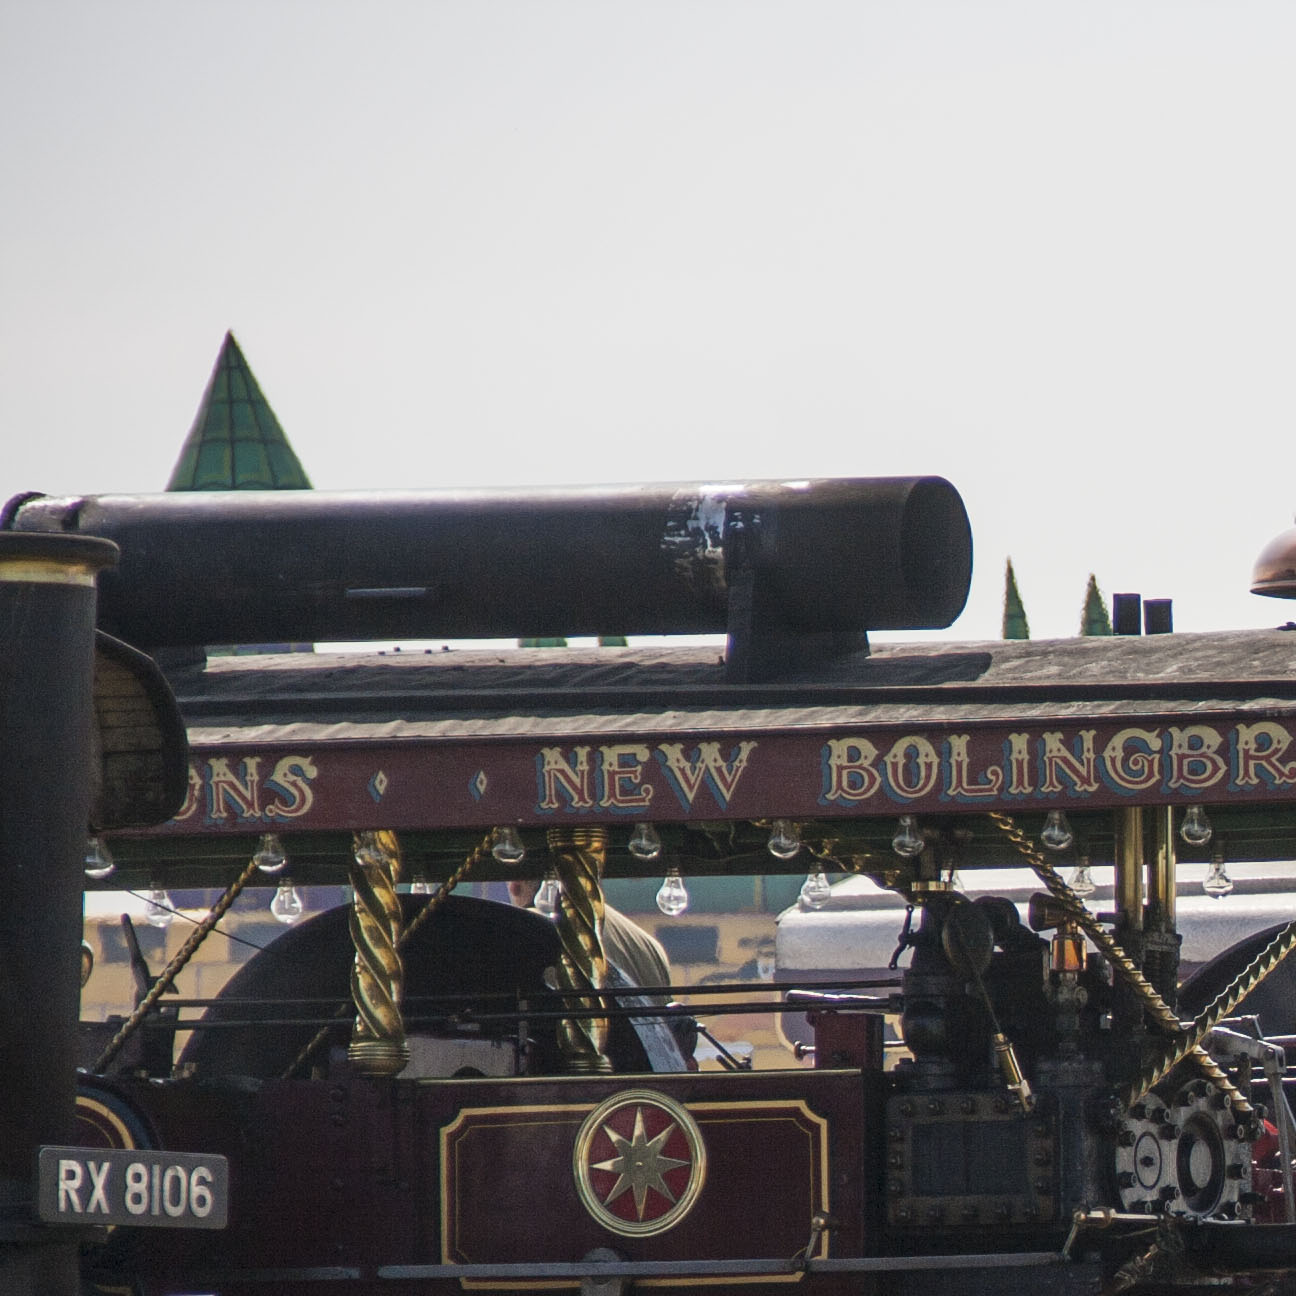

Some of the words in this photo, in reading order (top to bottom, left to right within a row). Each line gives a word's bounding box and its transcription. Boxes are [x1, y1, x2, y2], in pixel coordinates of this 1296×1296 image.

[537, 740, 757, 811] NEW
[58, 1159, 111, 1214] RX
[124, 1162, 214, 1218] 8106
